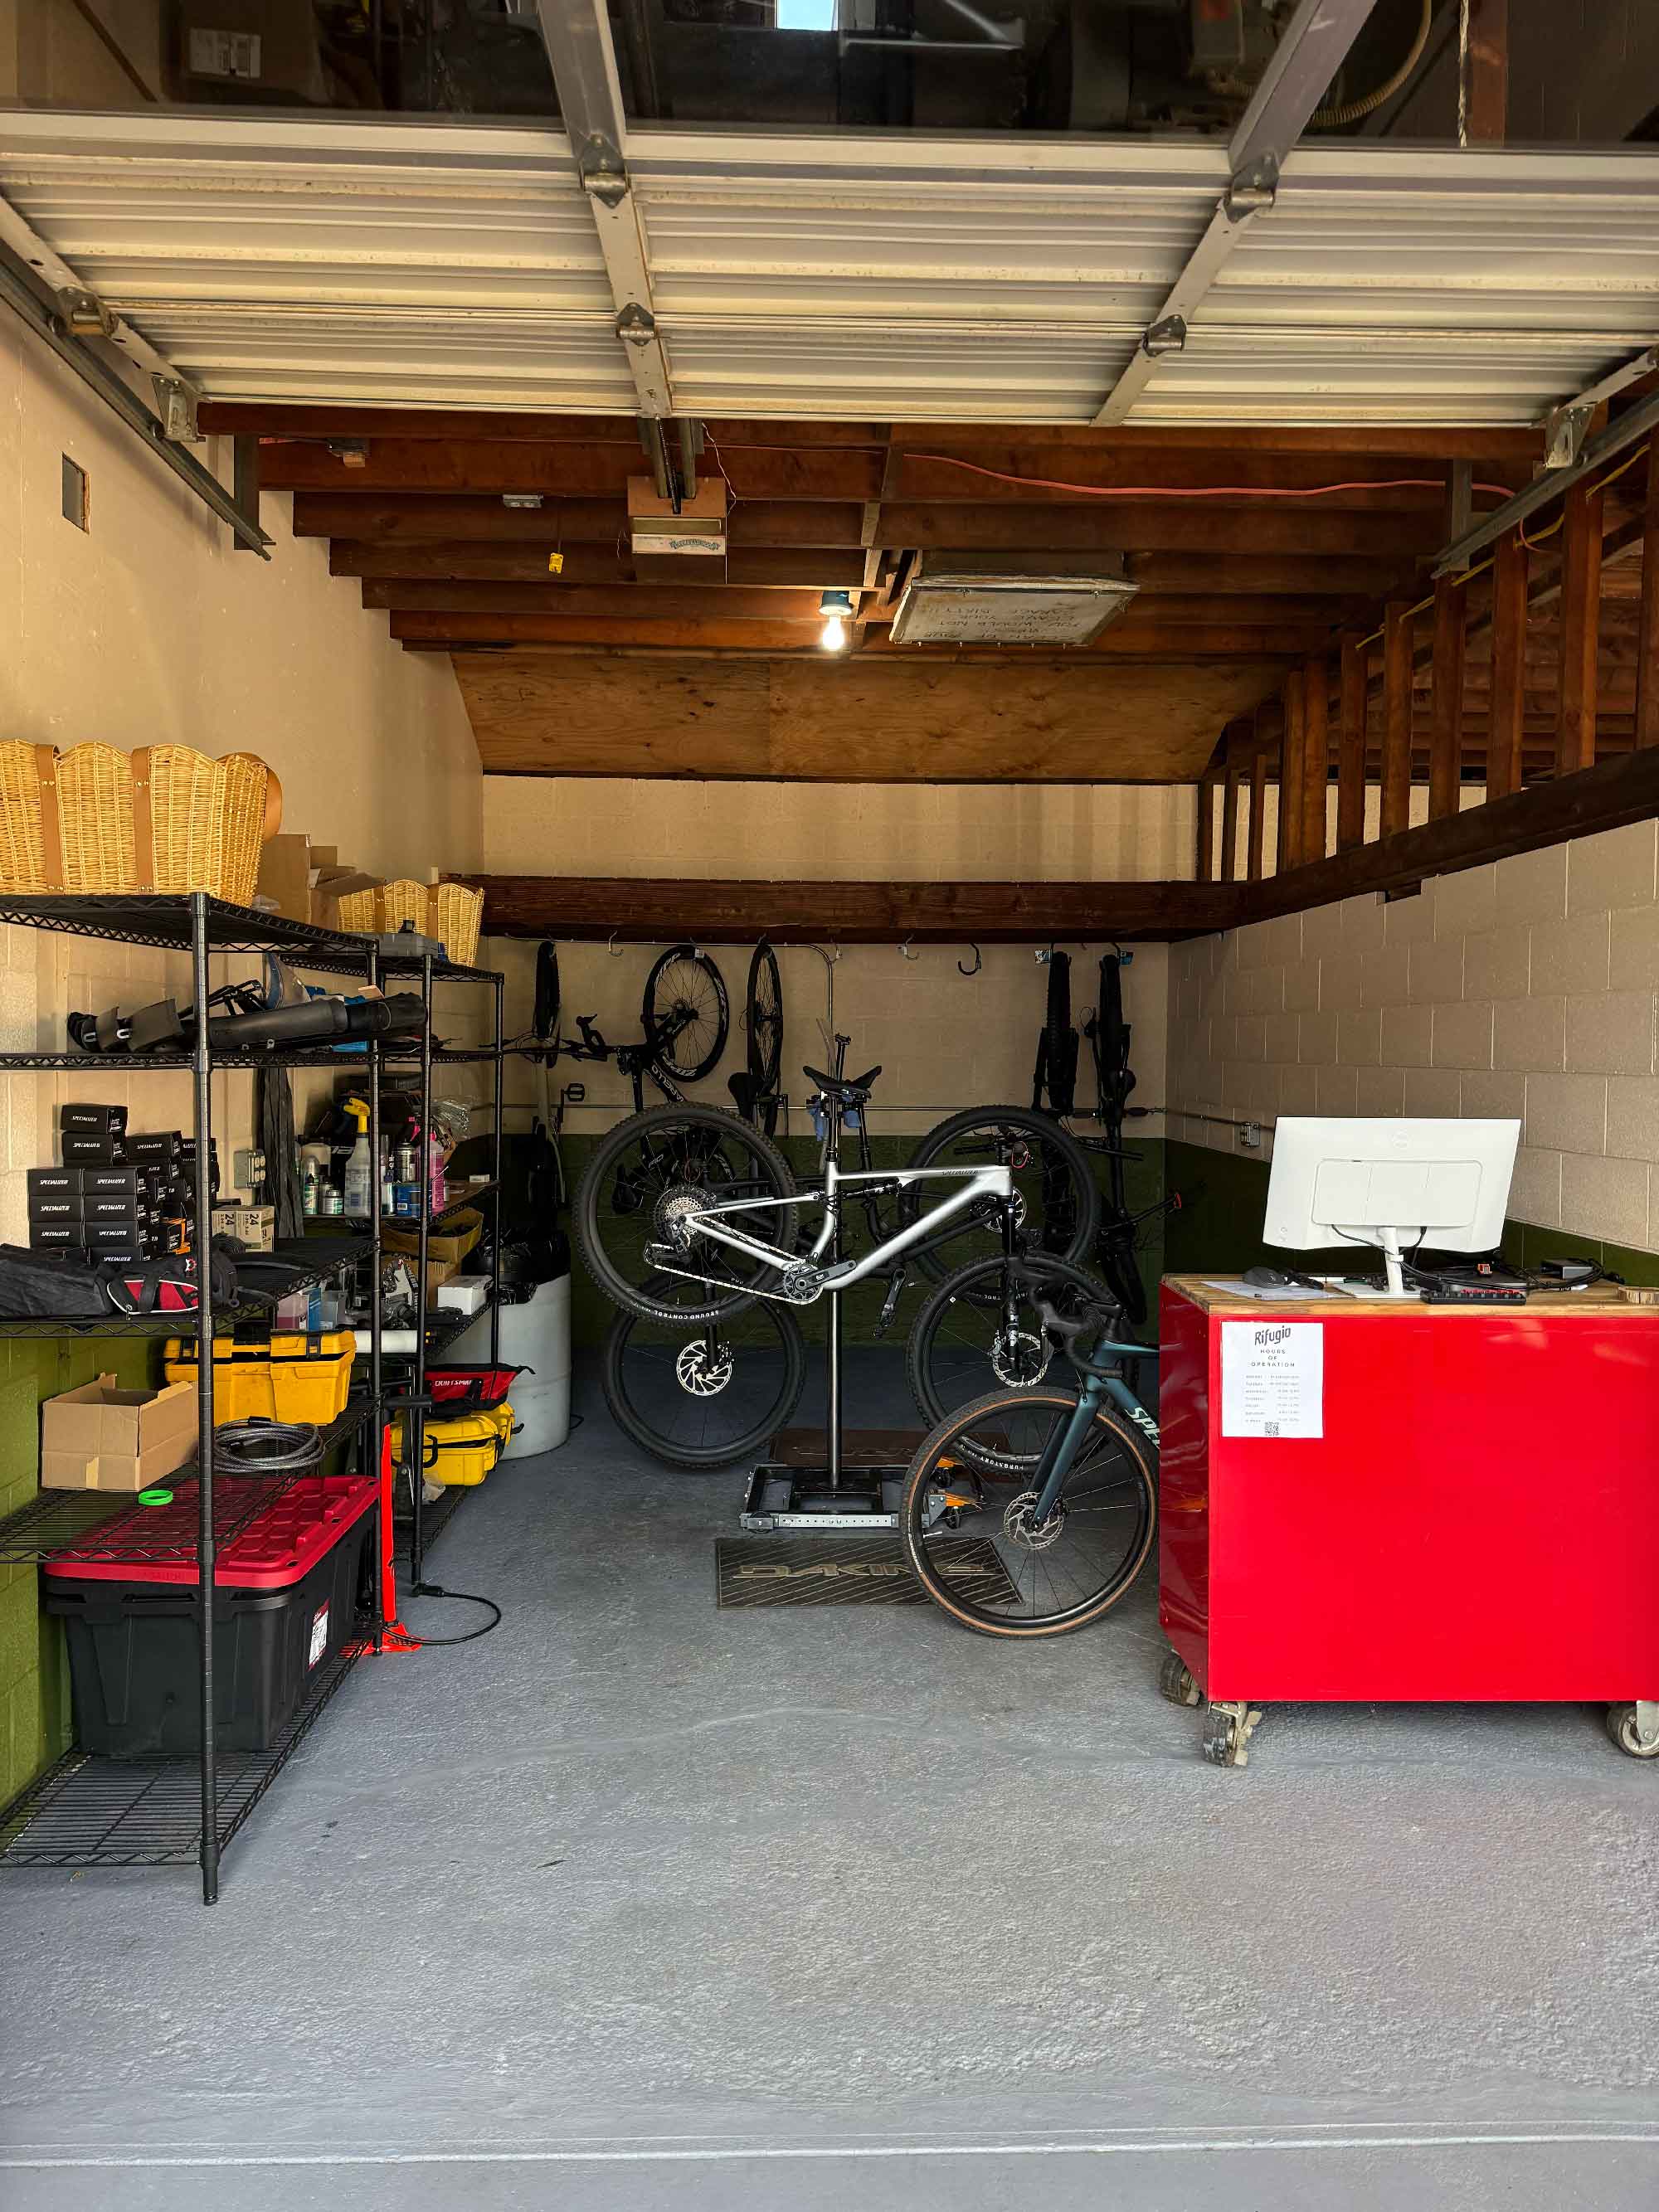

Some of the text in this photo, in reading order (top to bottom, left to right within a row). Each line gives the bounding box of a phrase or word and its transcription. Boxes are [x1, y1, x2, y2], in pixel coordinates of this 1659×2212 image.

[226, 1213, 235, 1226] 24
[250, 1213, 260, 1226] 24
[654, 1310, 688, 1320] CONTROL
[1254, 1325, 1292, 1346] Rifugio
